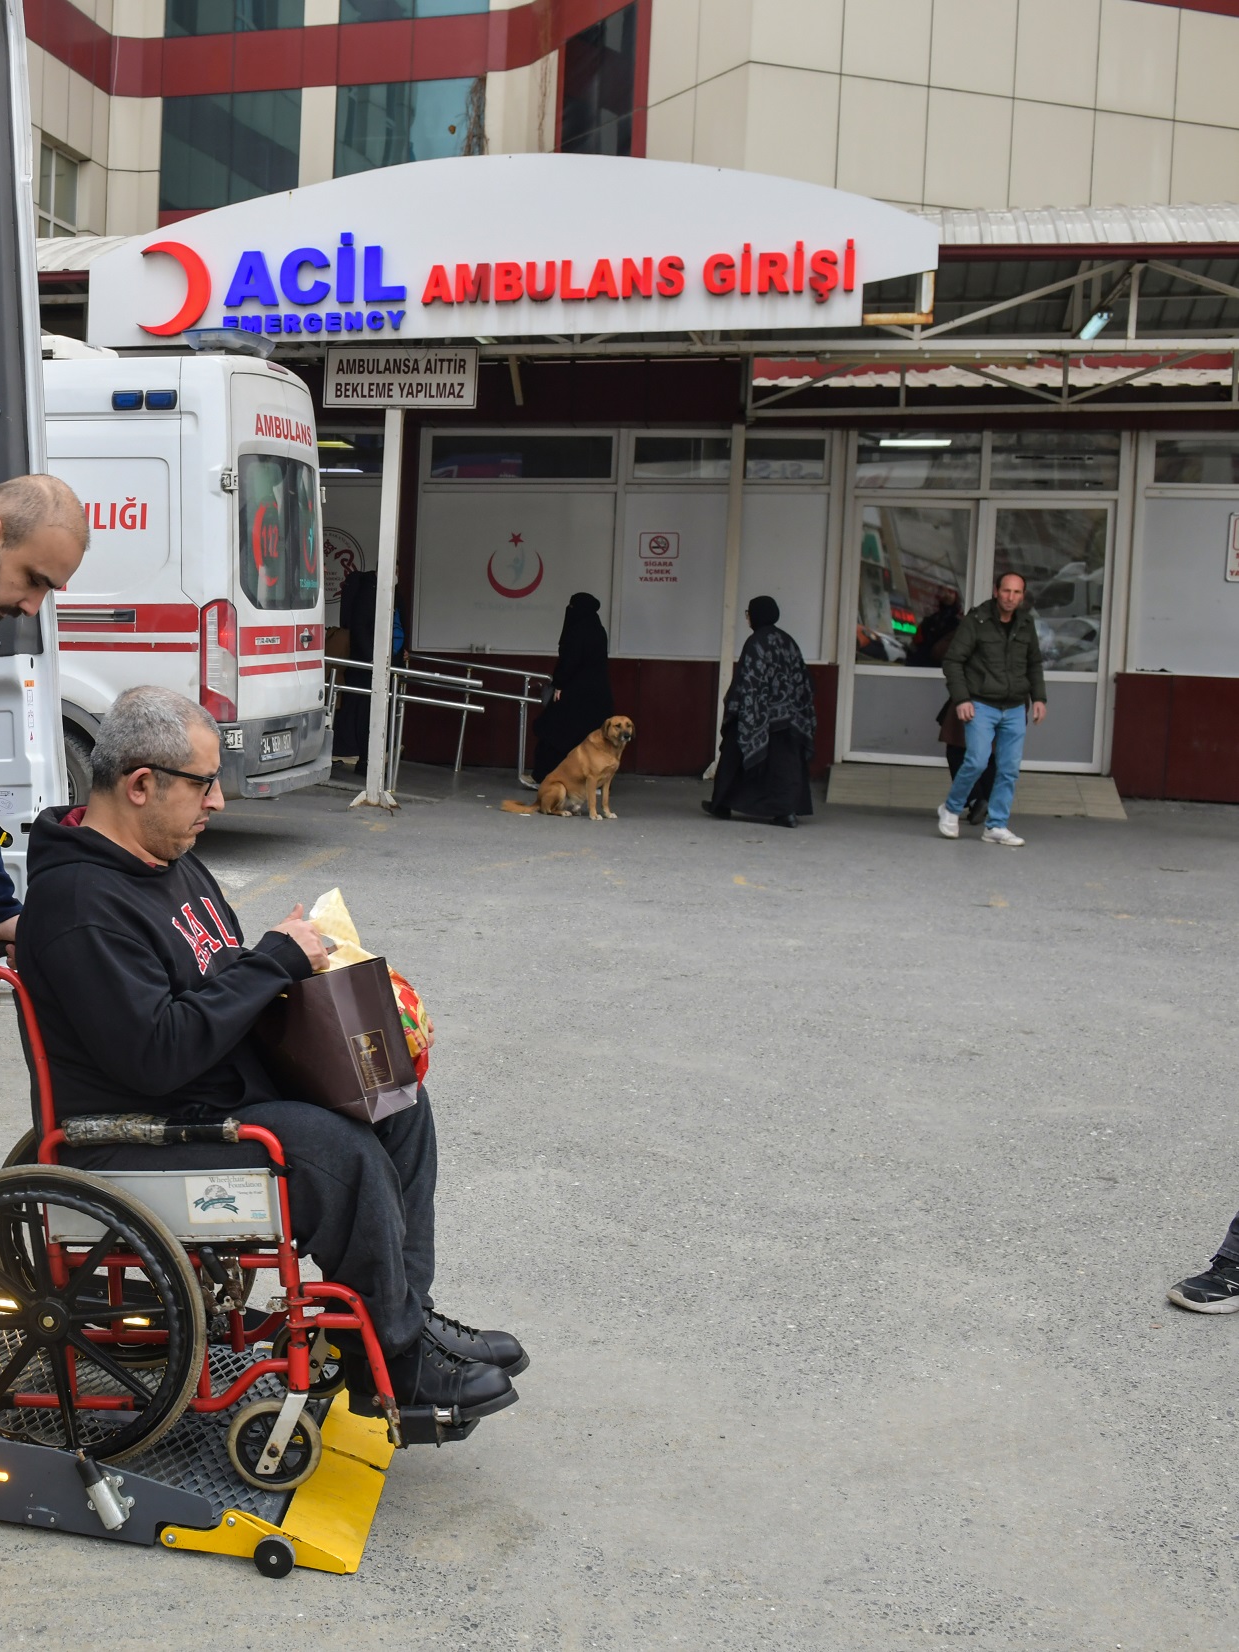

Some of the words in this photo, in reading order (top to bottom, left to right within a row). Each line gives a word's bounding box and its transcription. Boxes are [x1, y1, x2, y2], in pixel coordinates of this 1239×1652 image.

[223, 232, 407, 307] ACİL
[420, 255, 685, 305] AMBULANS
[703, 238, 855, 303] GİRİŞİ
[222, 310, 407, 334] EMERGENCY
[336, 358, 420, 375] AMBULANSA
[423, 353, 467, 375] AİTTİR
[335, 382, 394, 398] BEKLEME
[397, 382, 465, 399] YAPILMAZ
[255, 413, 313, 447] AMBULANS
[262, 736, 271, 754] 34
